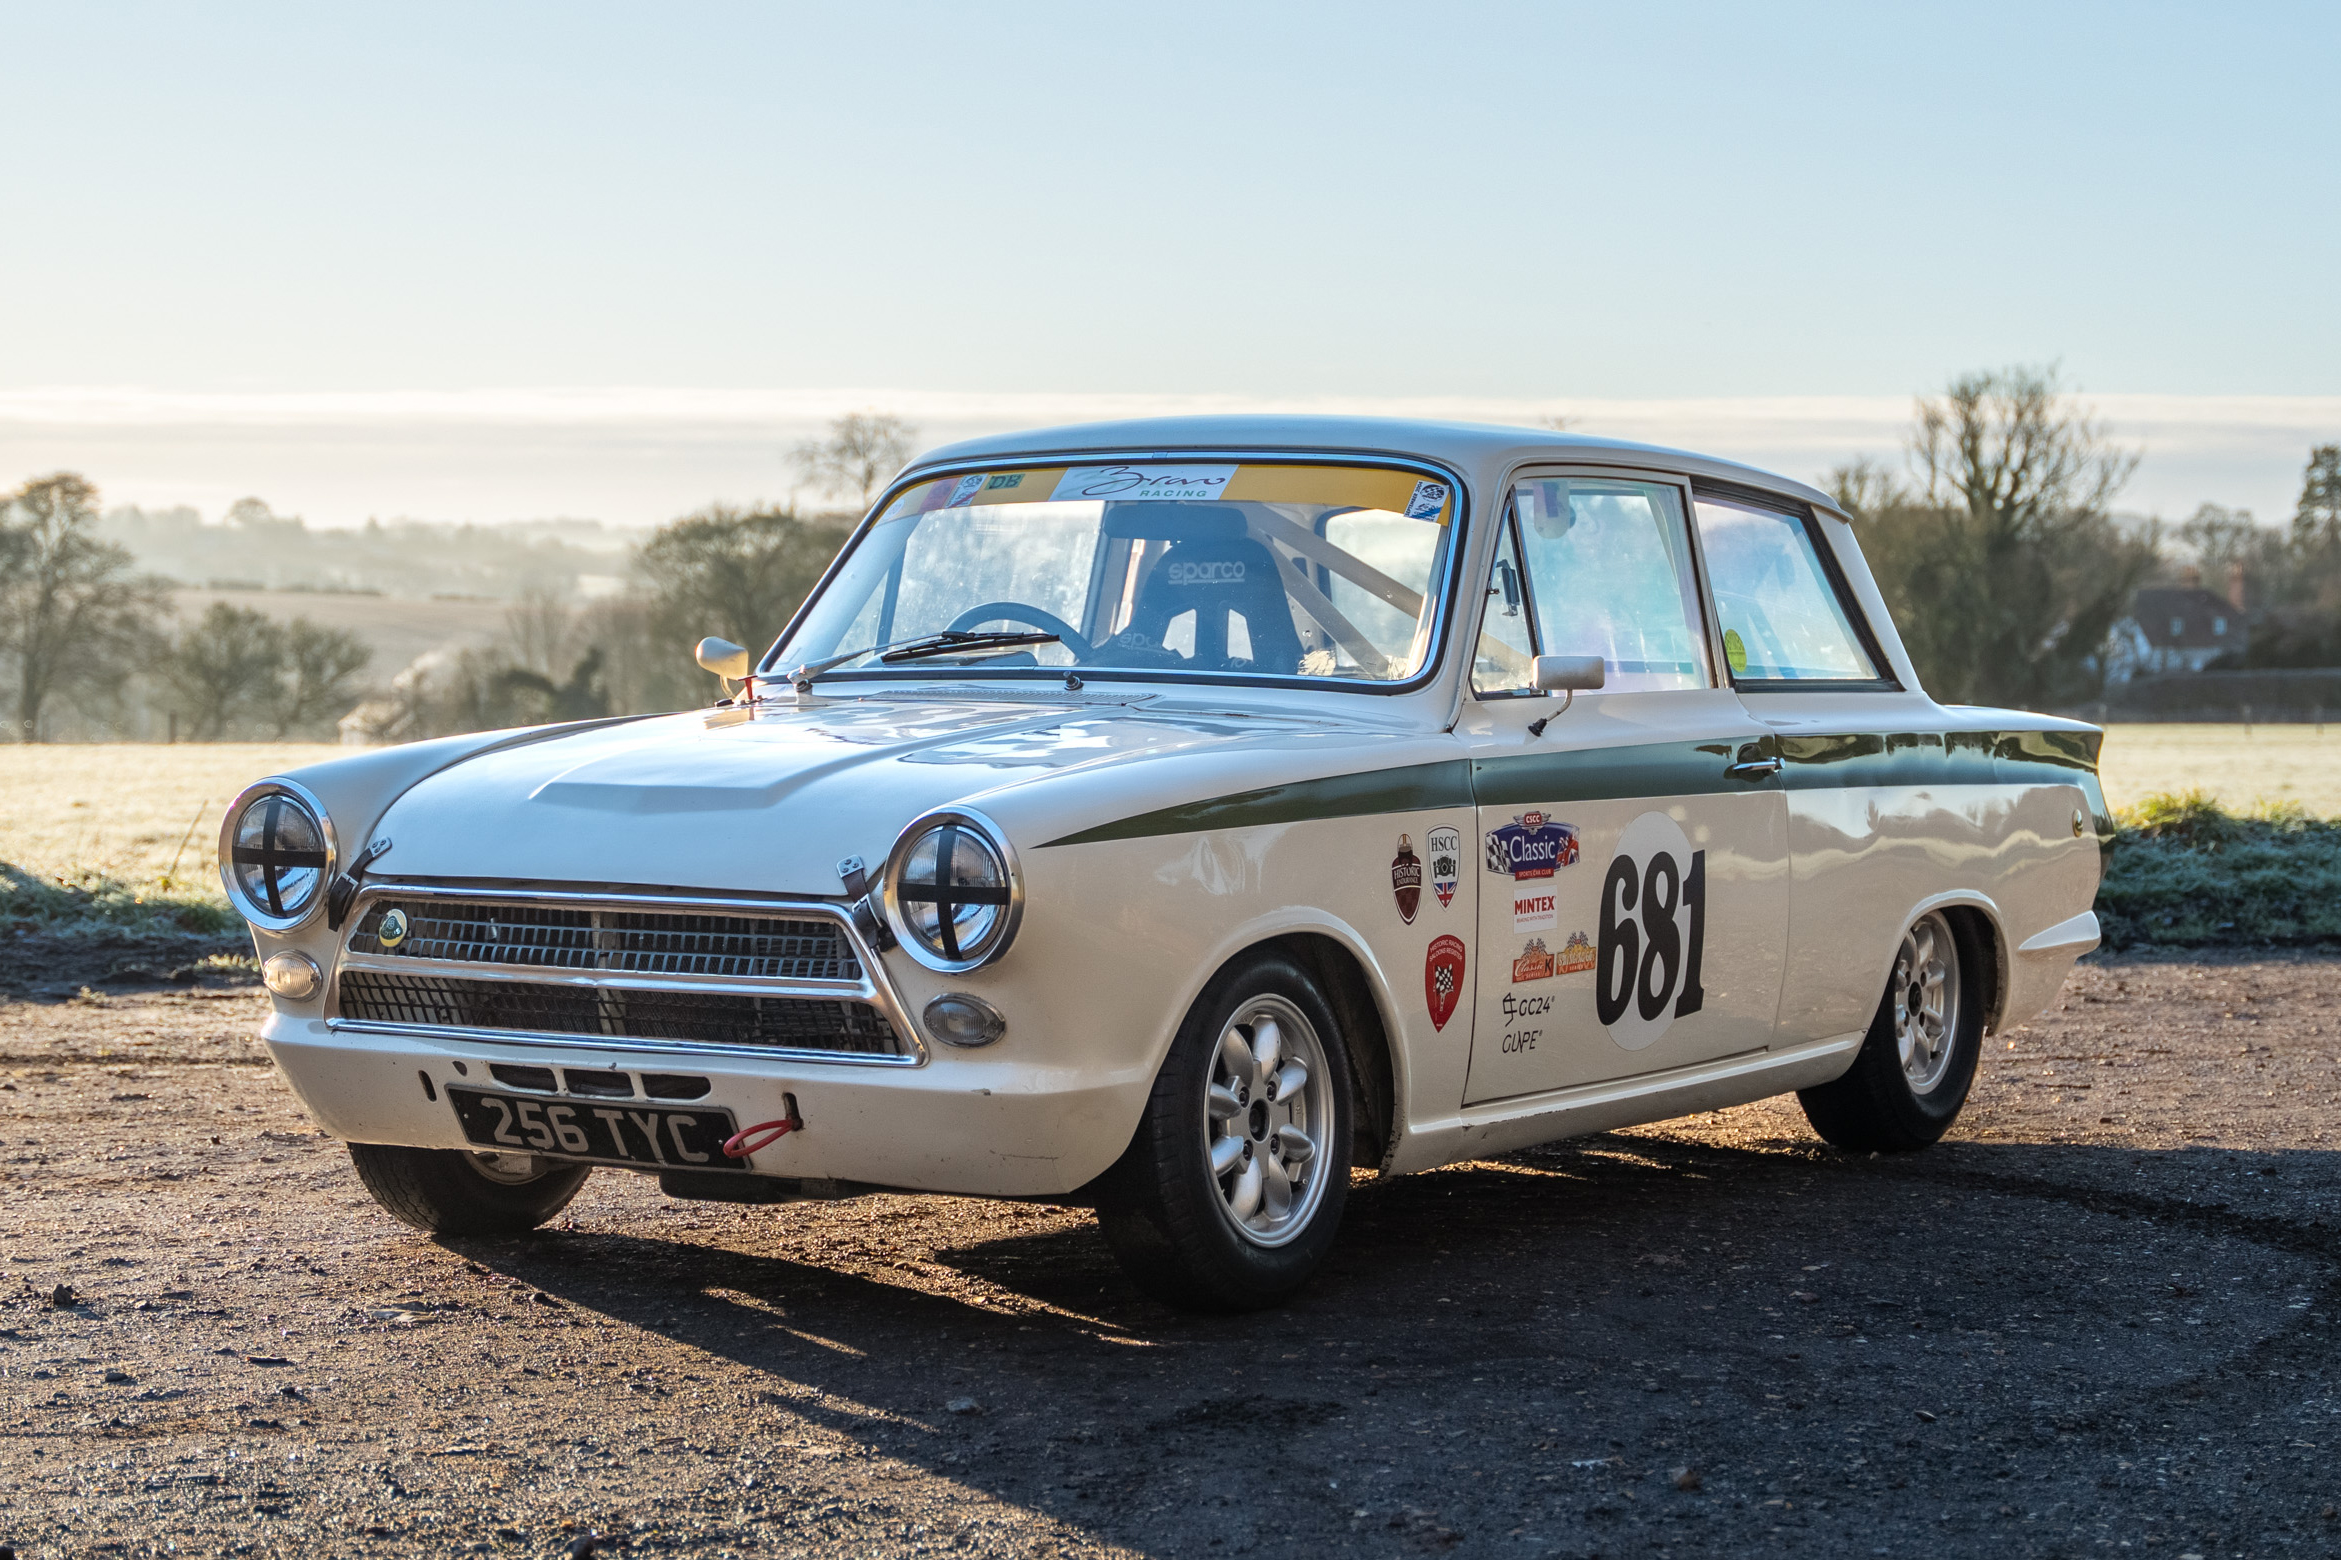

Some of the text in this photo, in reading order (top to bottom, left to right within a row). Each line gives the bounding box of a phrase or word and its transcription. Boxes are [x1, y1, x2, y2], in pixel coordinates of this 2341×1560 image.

[989, 475, 1021, 489] DB
[1168, 561, 1246, 585] sparco
[1525, 815, 1540, 823] CSCC
[1431, 836, 1458, 851] HSCC
[1509, 835, 1556, 862] Classic
[1394, 866, 1420, 880] HISTORIC
[1514, 895, 1555, 915] MINTEX
[1596, 849, 1705, 1026] 681
[1544, 958, 1552, 973] K
[480, 1097, 710, 1163] 256 TYC
